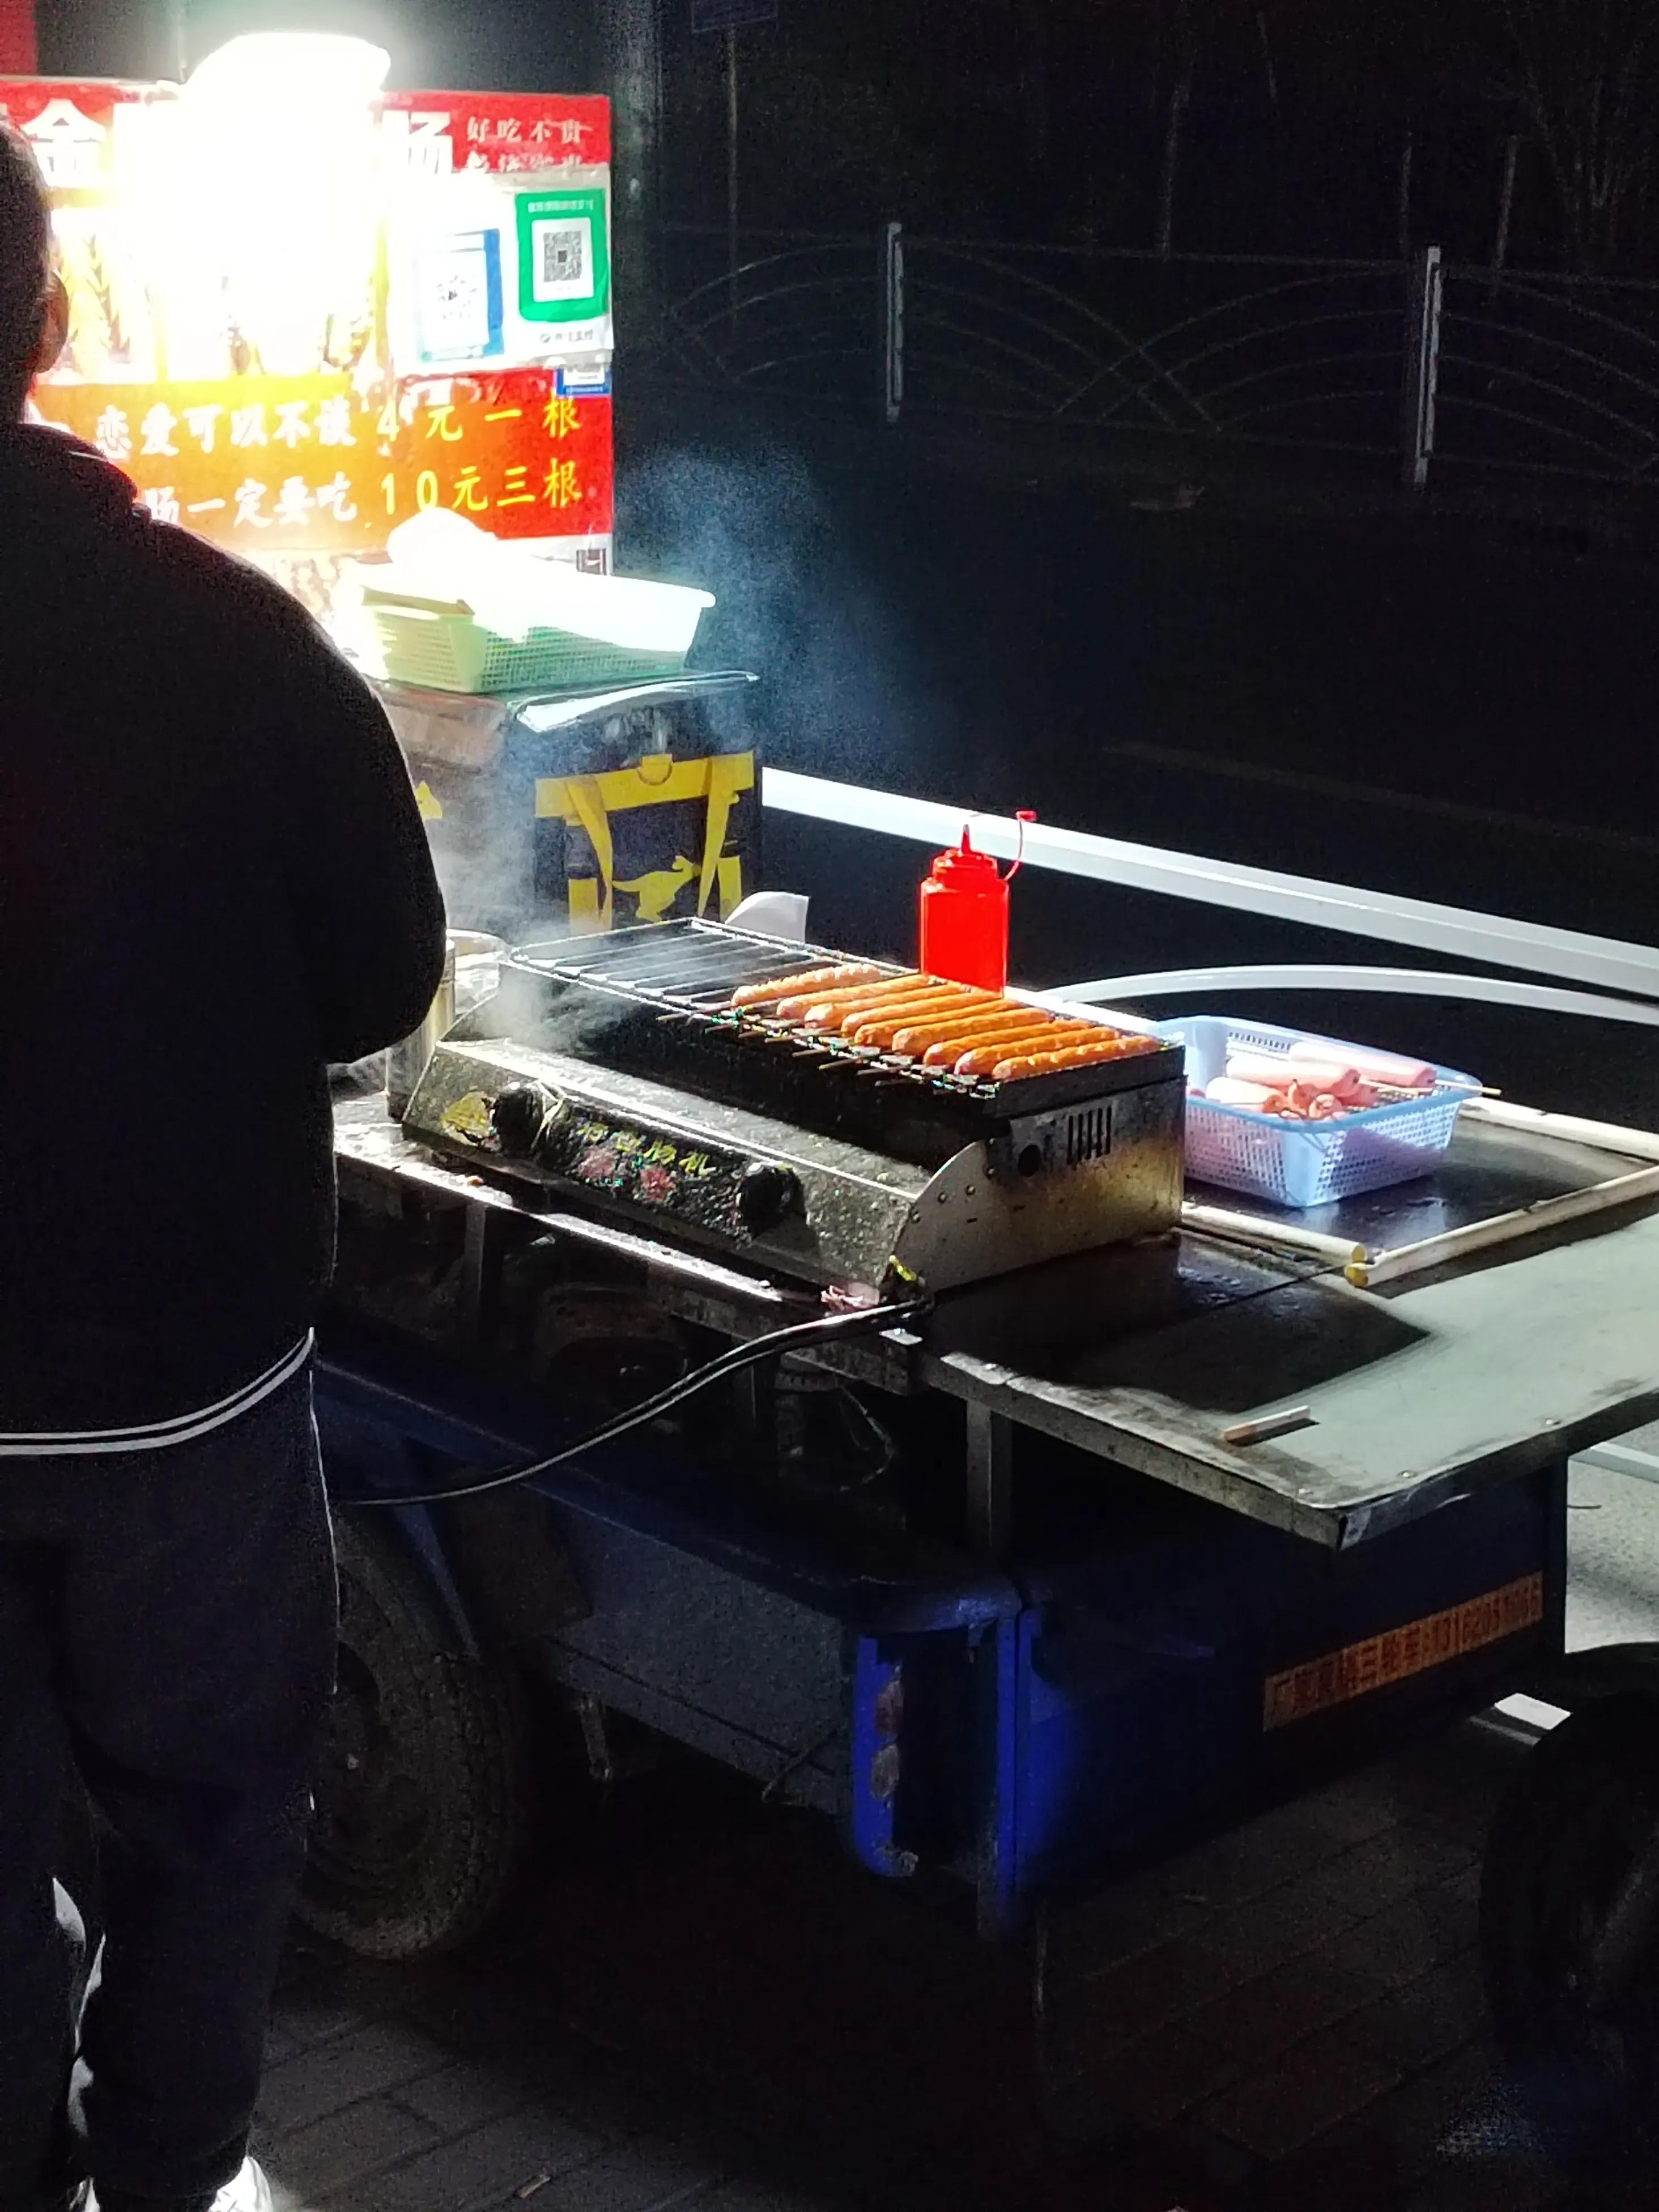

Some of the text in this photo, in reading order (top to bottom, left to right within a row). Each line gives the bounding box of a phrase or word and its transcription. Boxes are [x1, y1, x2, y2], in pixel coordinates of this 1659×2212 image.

[467, 116, 581, 144] 好吃不贵
[96, 395, 358, 460] 恋爱可以不谈
[376, 387, 582, 443] 4元一根
[380, 458, 582, 515] 10元三根
